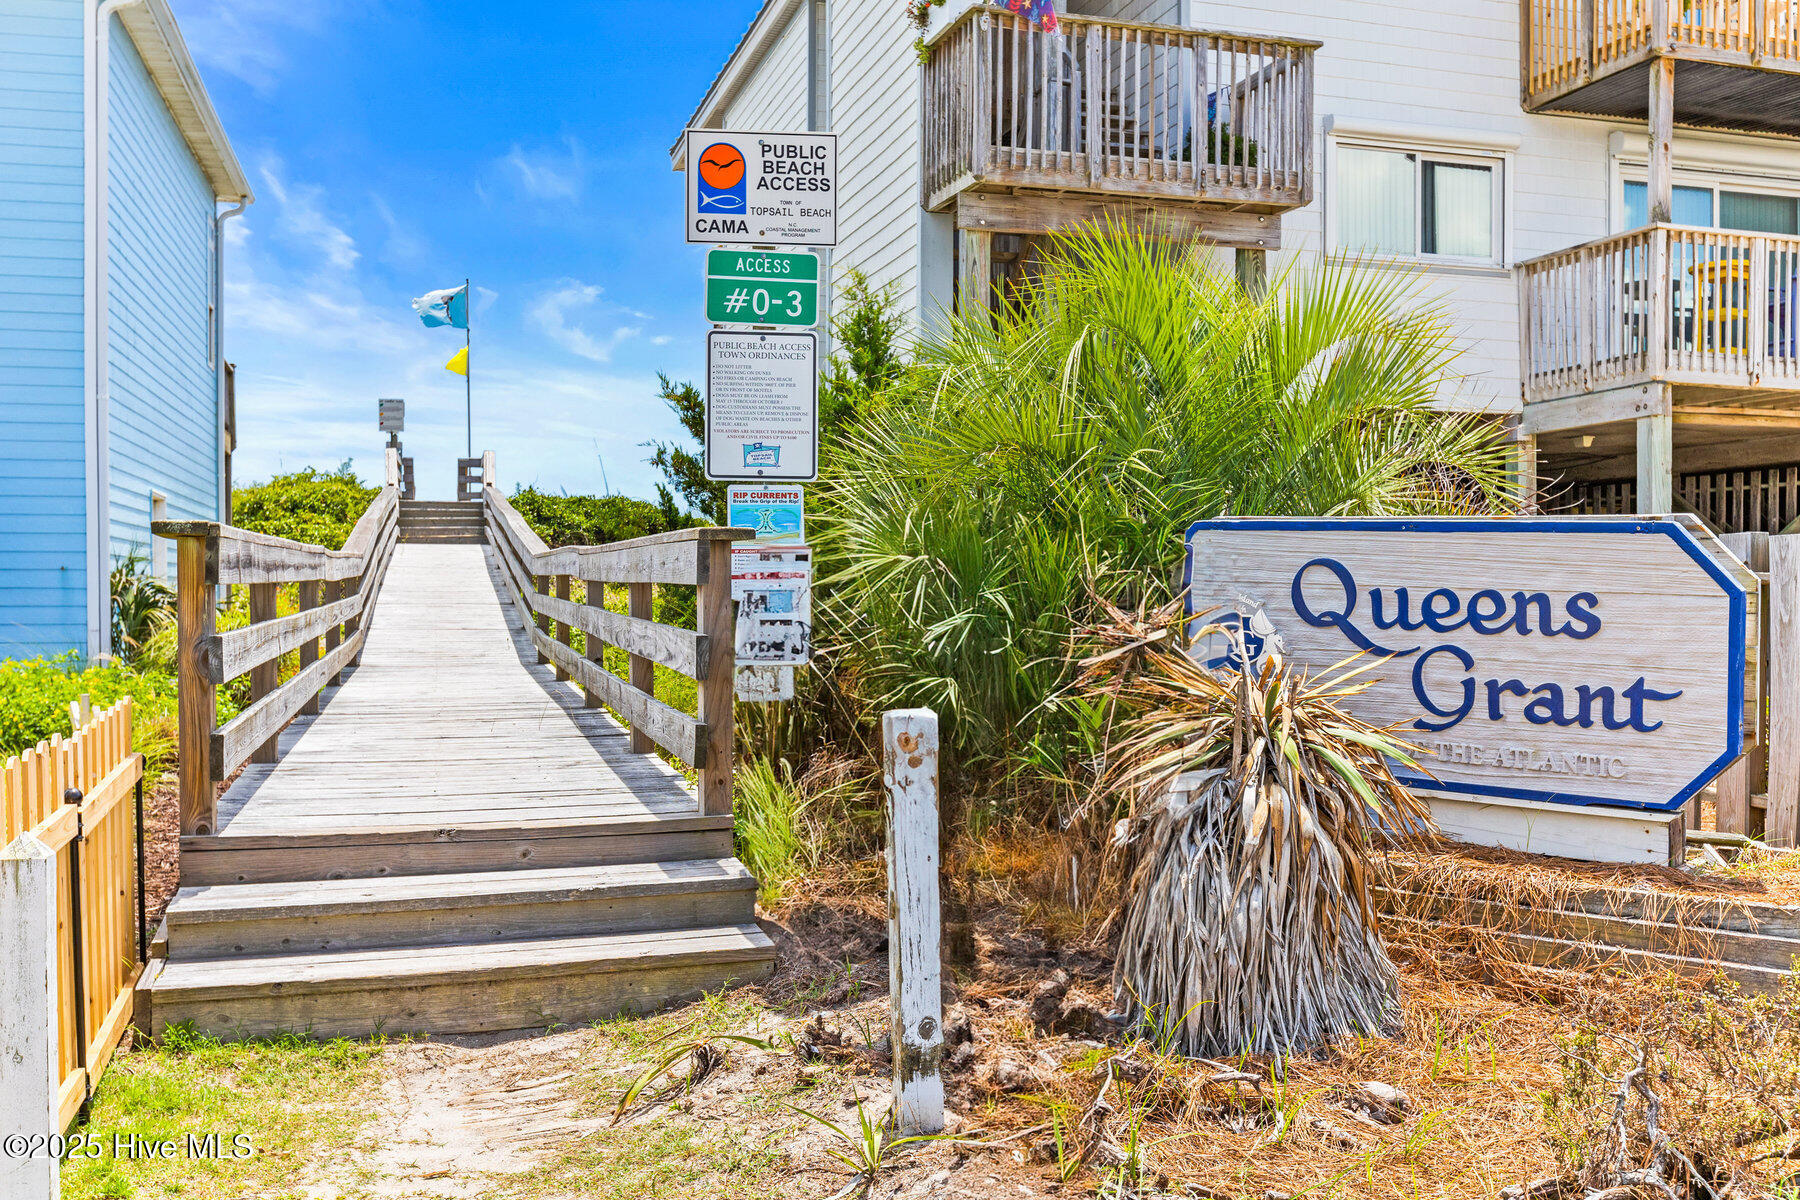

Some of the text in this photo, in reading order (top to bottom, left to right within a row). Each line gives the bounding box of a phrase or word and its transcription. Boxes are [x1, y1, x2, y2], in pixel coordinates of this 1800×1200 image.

[761, 144, 827, 160] PUBLIC
[763, 160, 825, 176] BEACH
[757, 177, 830, 192] ACCESS
[750, 207, 832, 217] TOPSAIL BEACH
[695, 219, 749, 234] CAMA
[736, 257, 790, 273] ACCESS
[723, 288, 802, 317] #0-3
[713, 341, 811, 351] PUBLIC BEACH ACCESS
[718, 351, 806, 360] TOWN ORDINANCES
[1290, 557, 1602, 657] Queens
[1412, 644, 1683, 732] Grant
[1433, 741, 1483, 765] THE
[1492, 746, 1627, 778] ATLANTIC
